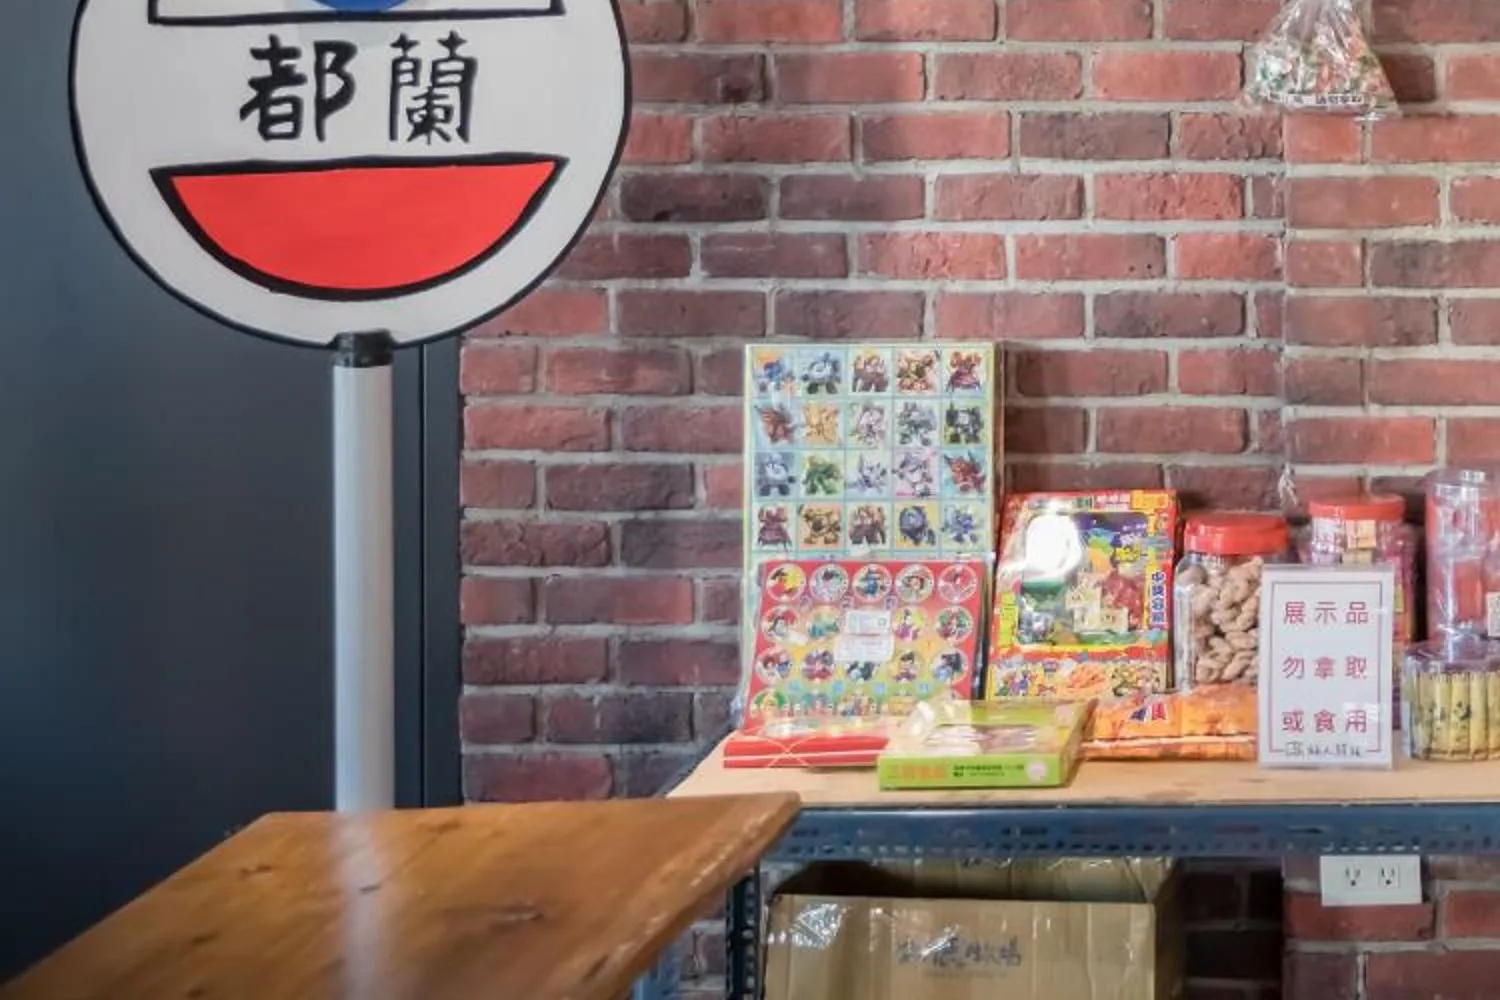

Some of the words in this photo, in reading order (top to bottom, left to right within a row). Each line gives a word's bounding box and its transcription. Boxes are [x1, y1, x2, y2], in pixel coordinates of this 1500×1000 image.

[239, 29, 478, 146] 都蘭
[1283, 600, 1370, 626] 展示品
[1281, 655, 1369, 681] 勿拿取
[1281, 708, 1368, 734] 或食用
